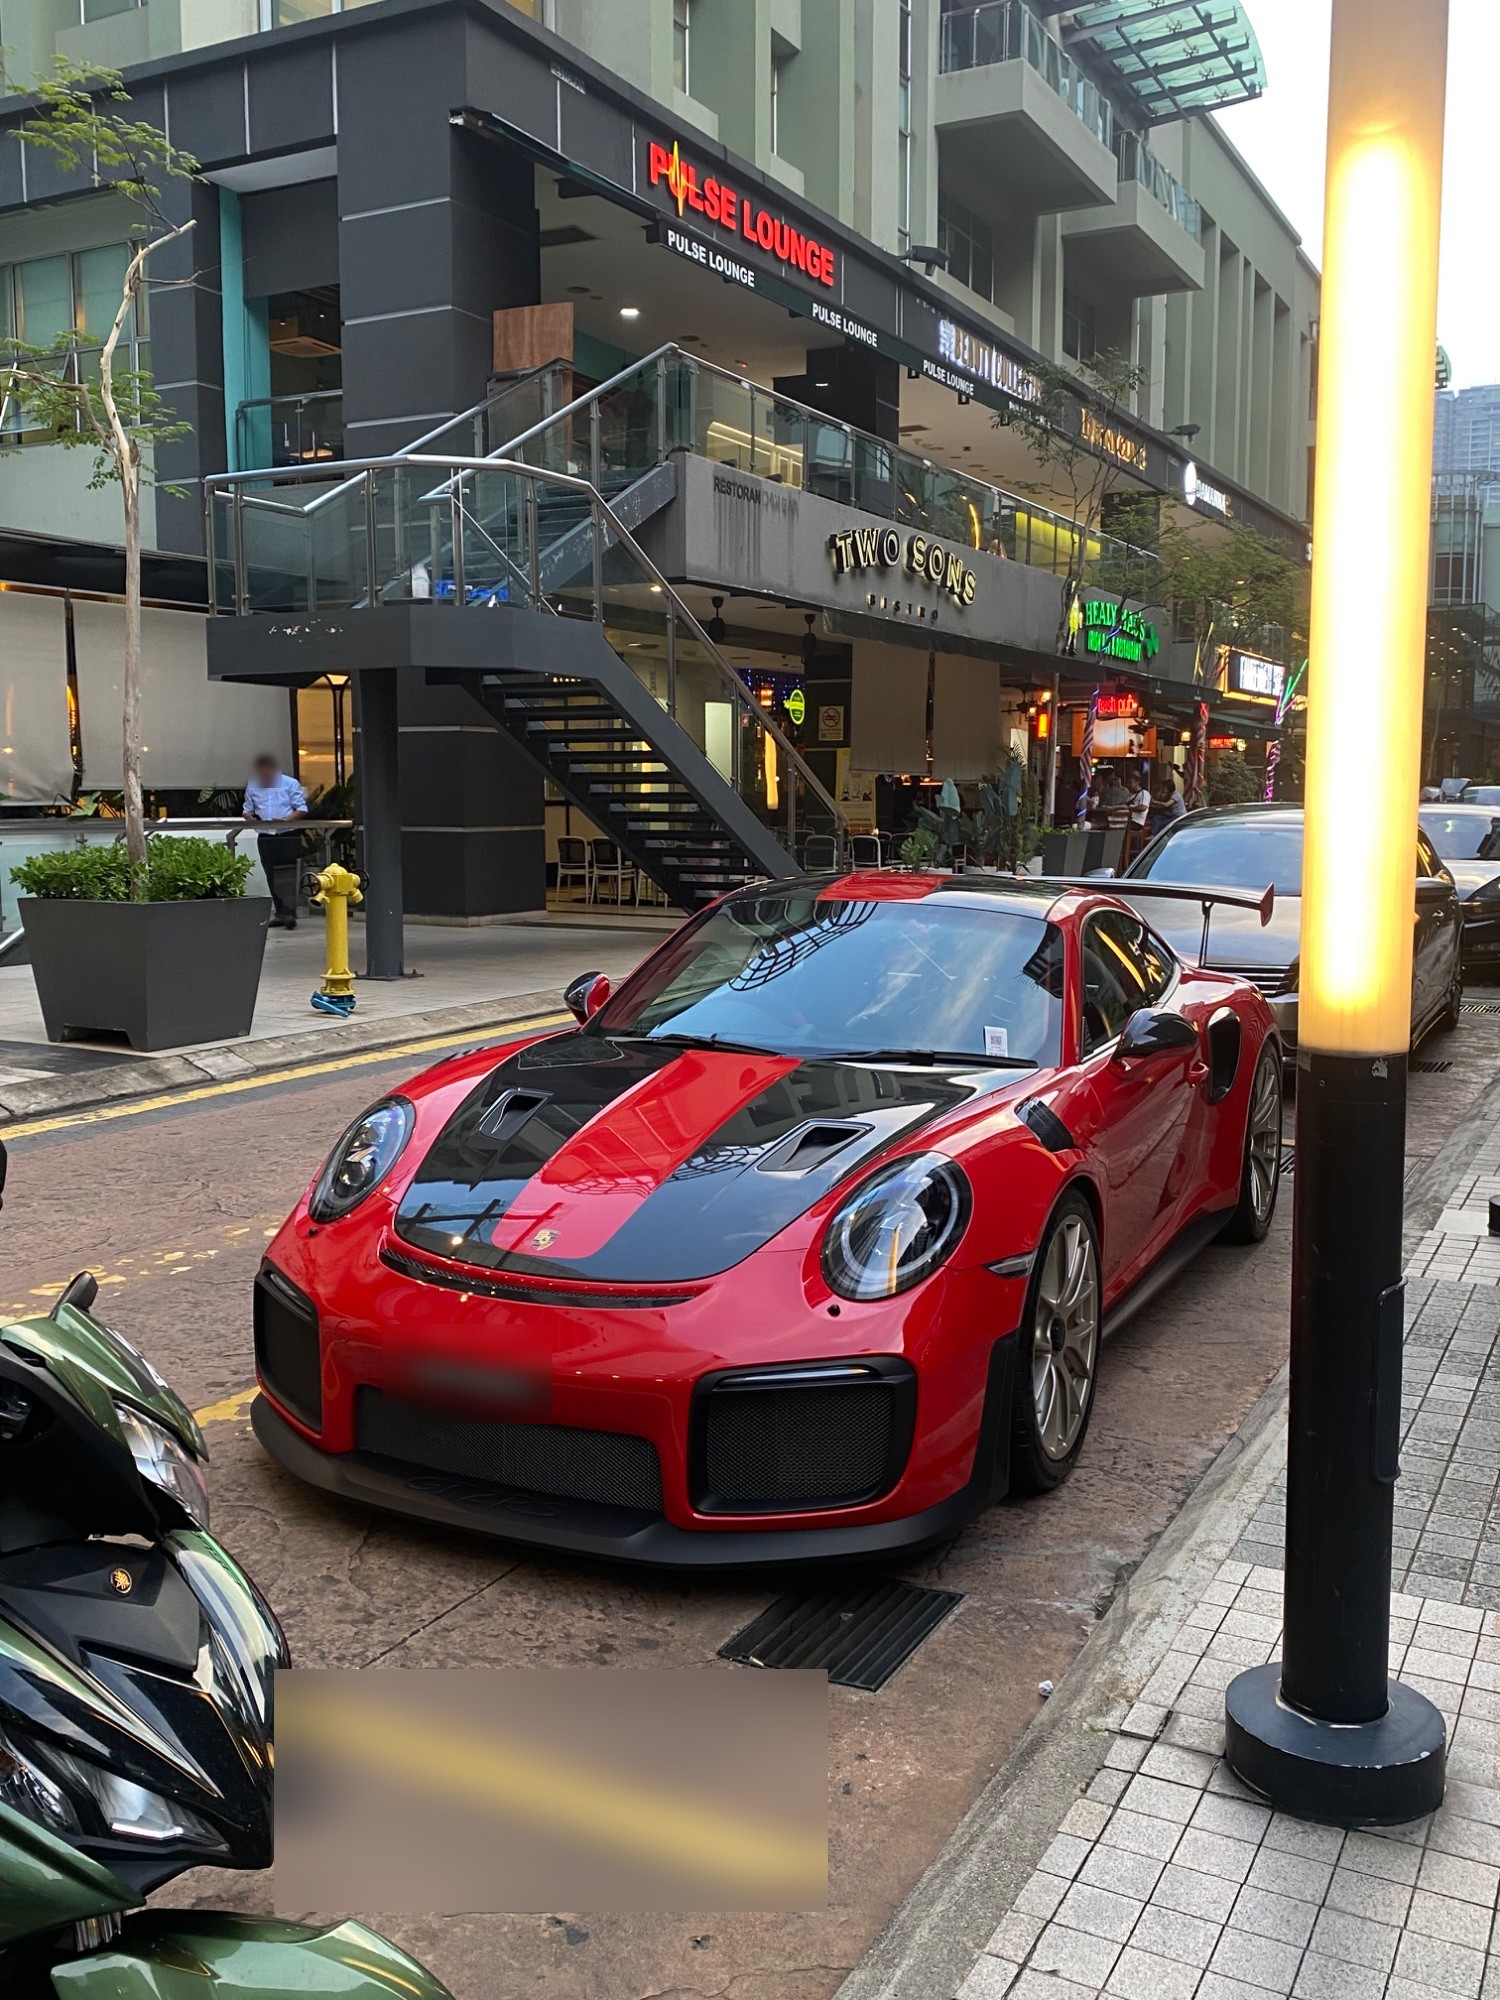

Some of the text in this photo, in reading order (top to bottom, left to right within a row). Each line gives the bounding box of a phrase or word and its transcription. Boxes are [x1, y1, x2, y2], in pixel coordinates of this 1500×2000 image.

[649, 141, 835, 288] PULSE LOUNGE
[667, 229, 755, 288] PULSE LOUNGE
[812, 302, 878, 348] PULSE LOUNGE
[923, 359, 975, 397] PULSE LOUNGE
[714, 475, 761, 506] RESTORAN
[829, 528, 976, 606] TWO SONS
[868, 592, 939, 622] BISTRO
[1085, 600, 1118, 627] HEALY
